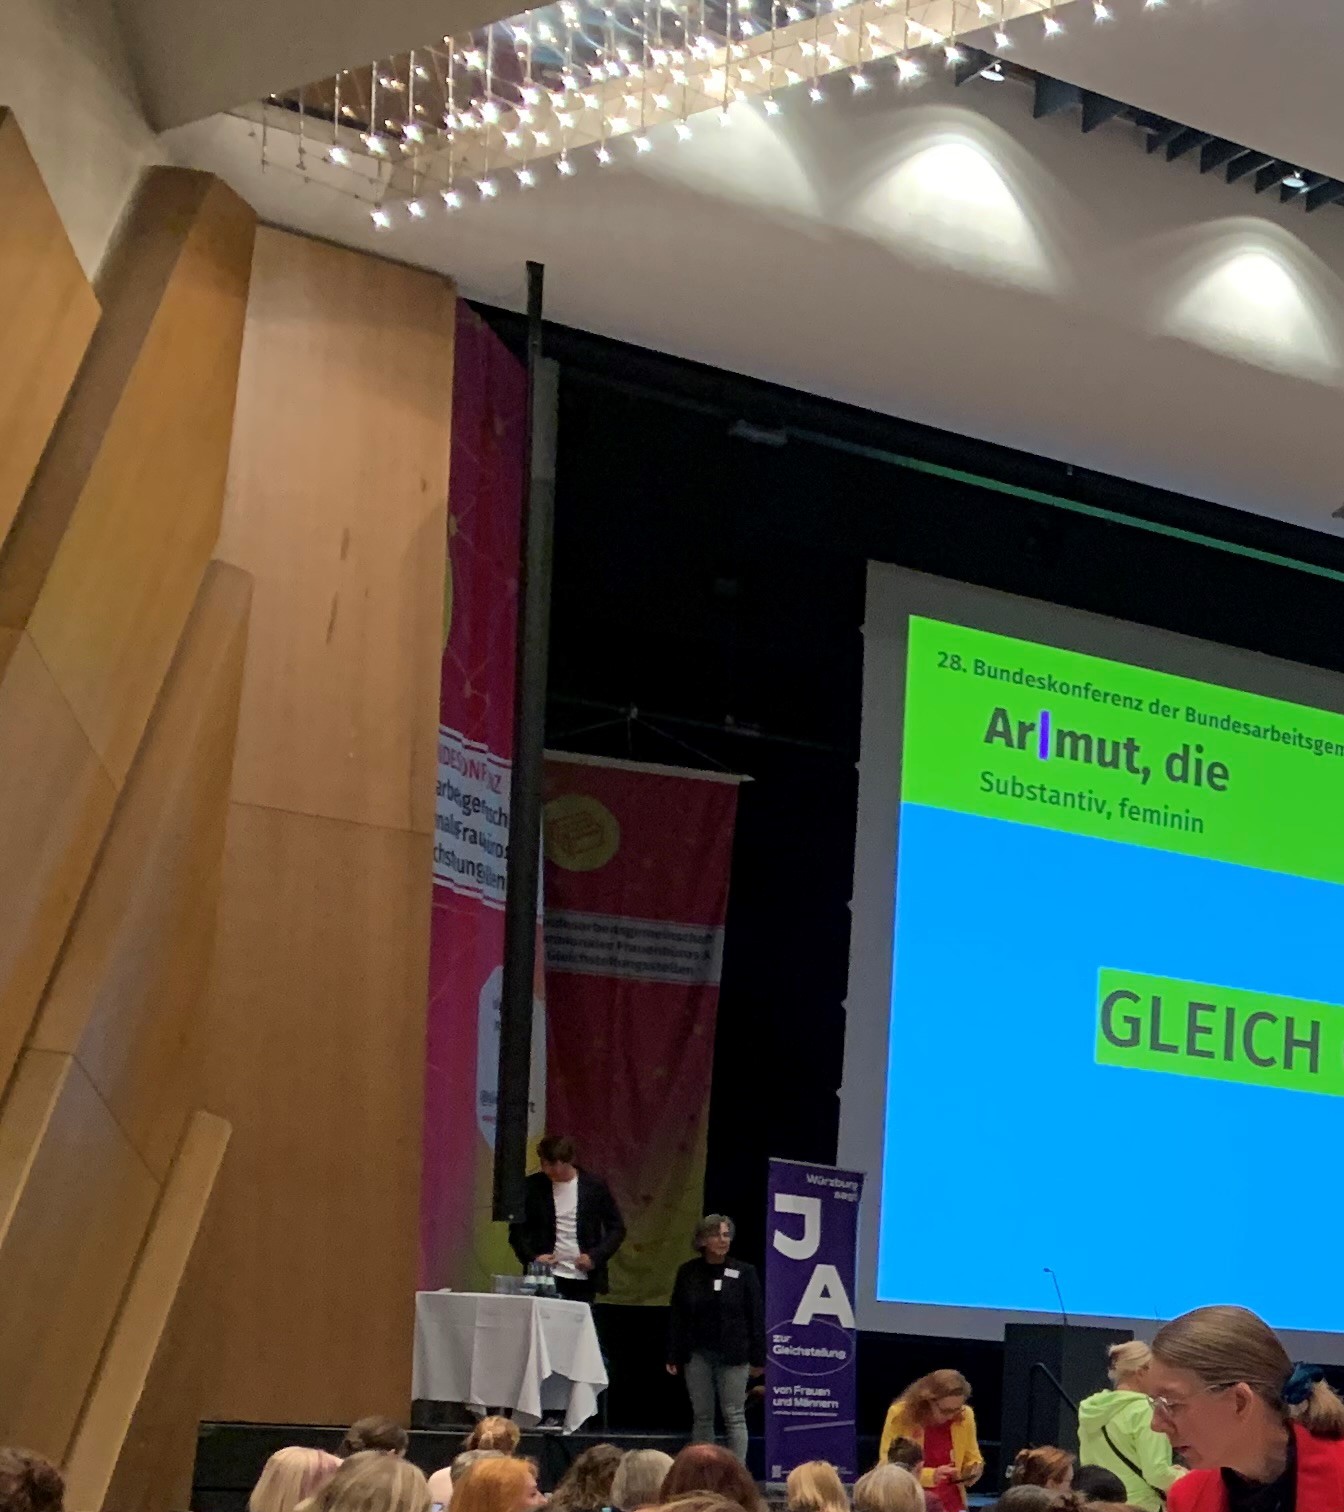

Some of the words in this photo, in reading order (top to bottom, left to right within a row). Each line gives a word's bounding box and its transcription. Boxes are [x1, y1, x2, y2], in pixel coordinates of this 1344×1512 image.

[938, 651, 967, 673] 28.
[973, 658, 1143, 712] Bundeskonferenz
[1148, 698, 1179, 719] der
[1165, 743, 1230, 792] die
[980, 770, 1112, 820] Substantiv,
[1119, 797, 1204, 833] feminin
[1100, 989, 1320, 1074] GLEICH
[772, 1344, 846, 1360] Gleichstellung
[773, 1398, 792, 1406] und
[794, 1385, 831, 1396] Frauen
